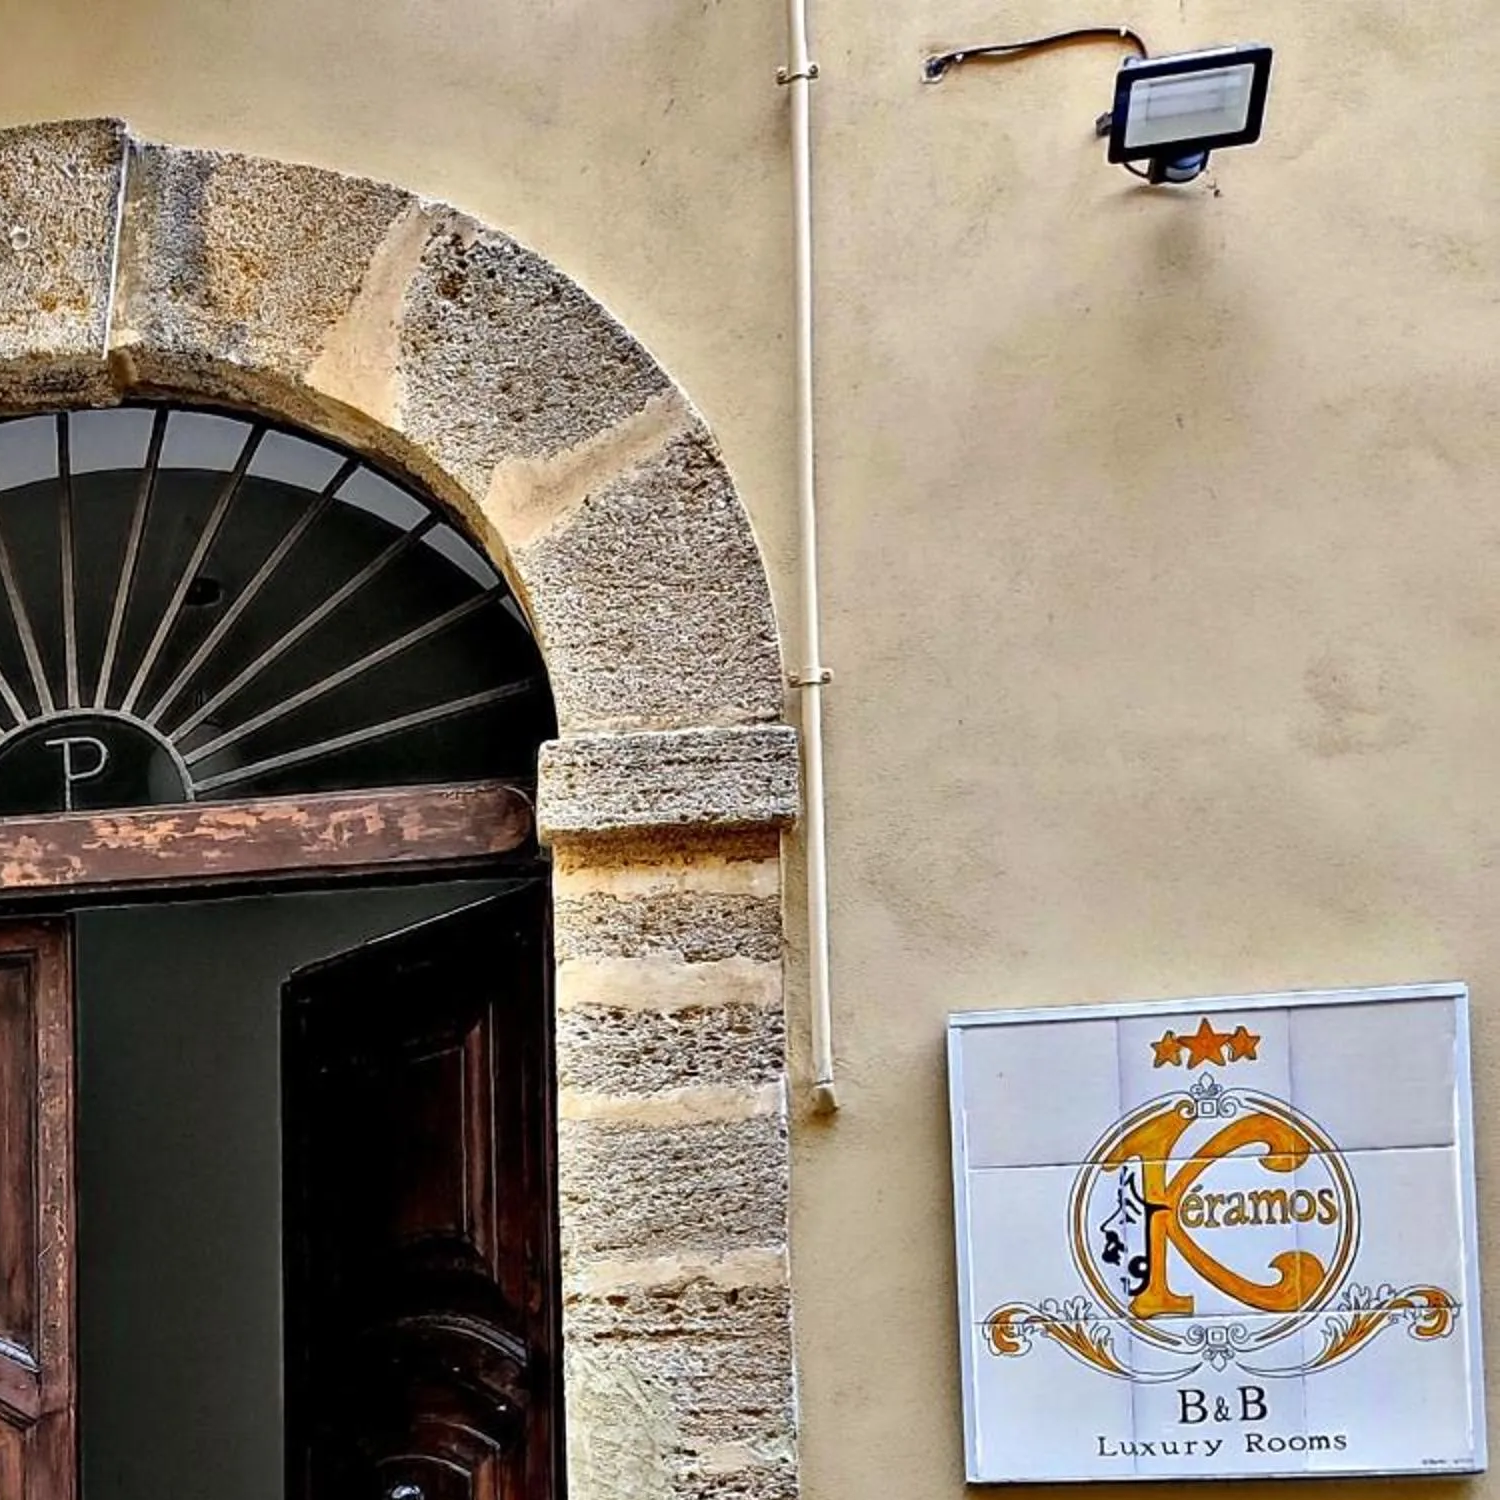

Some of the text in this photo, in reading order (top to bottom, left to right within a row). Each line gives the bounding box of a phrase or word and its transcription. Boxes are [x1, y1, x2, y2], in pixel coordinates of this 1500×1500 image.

[45, 736, 109, 812] P
[1101, 1110, 1338, 1320] Kéramos
[1097, 1432, 1348, 1457] Luxury Rooms
